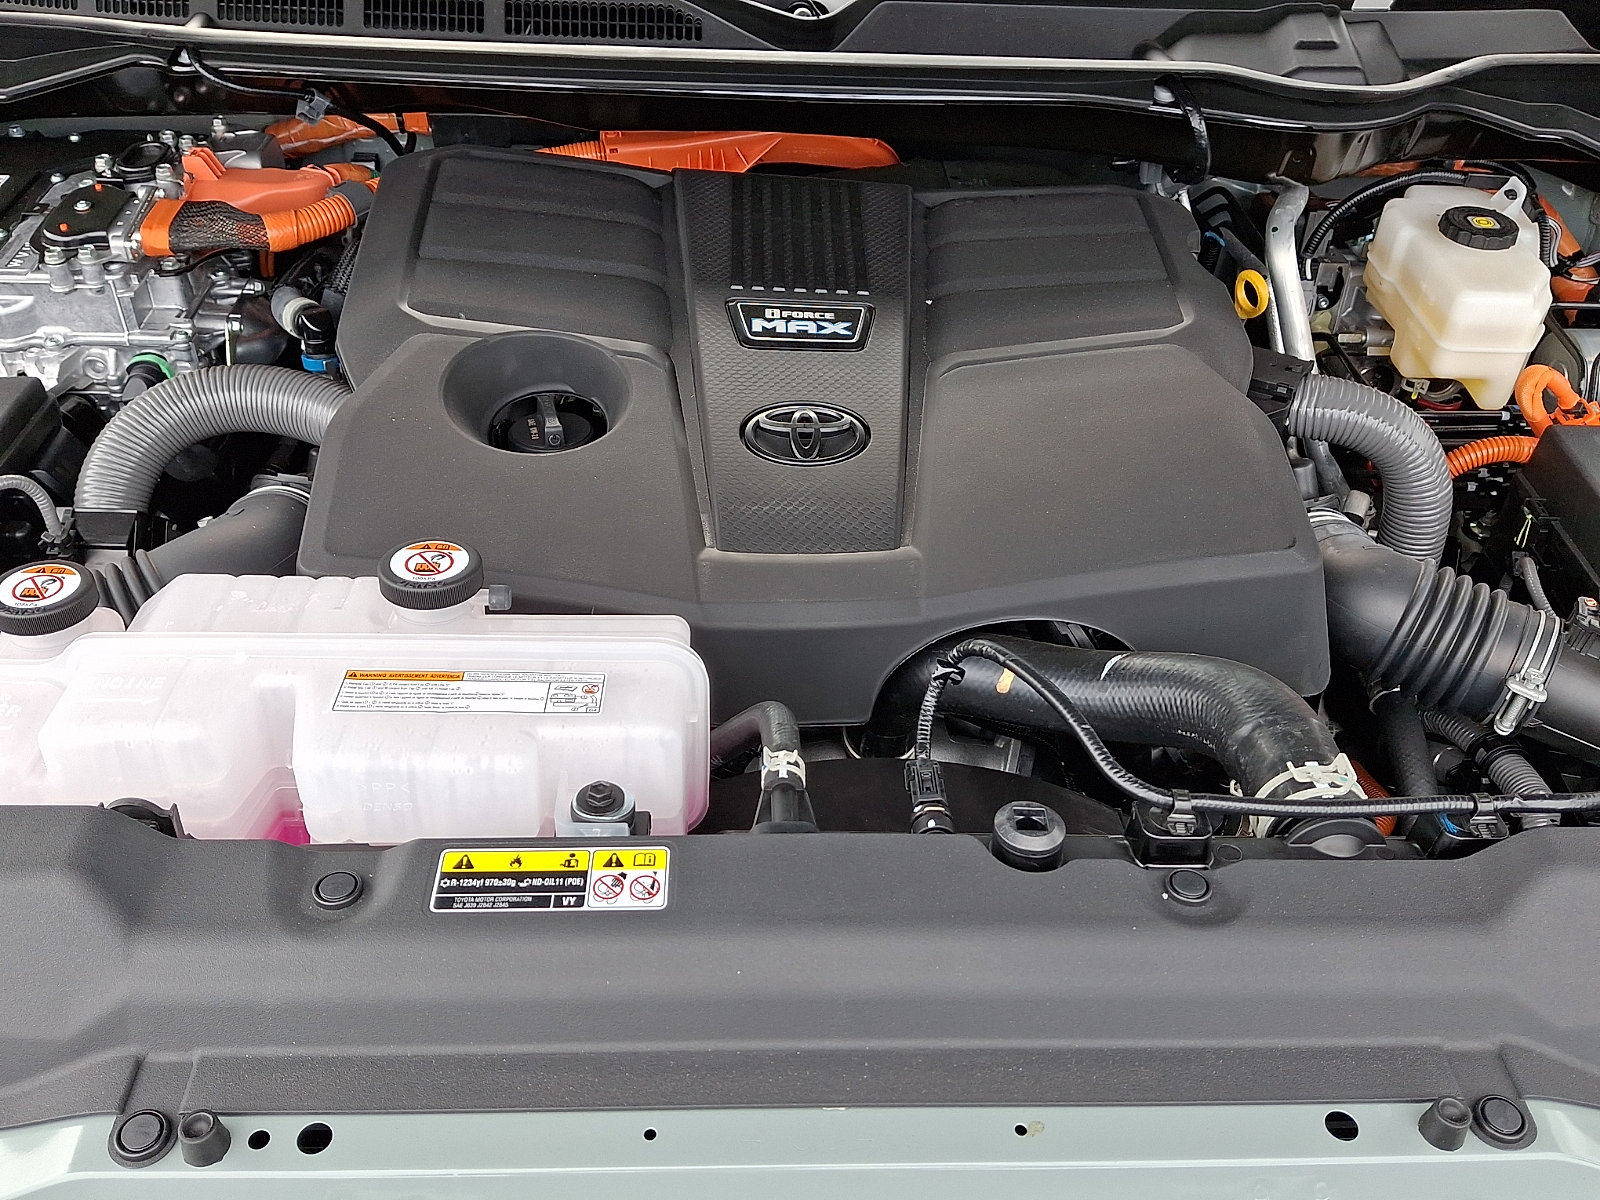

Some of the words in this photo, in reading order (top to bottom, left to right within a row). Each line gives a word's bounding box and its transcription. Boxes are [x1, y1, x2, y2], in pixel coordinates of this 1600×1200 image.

[781, 311, 835, 319] FORCE
[751, 318, 853, 335] MAX
[450, 878, 484, 888] R-1234yf
[564, 877, 584, 887] (POE)
[561, 896, 577, 906] VY
